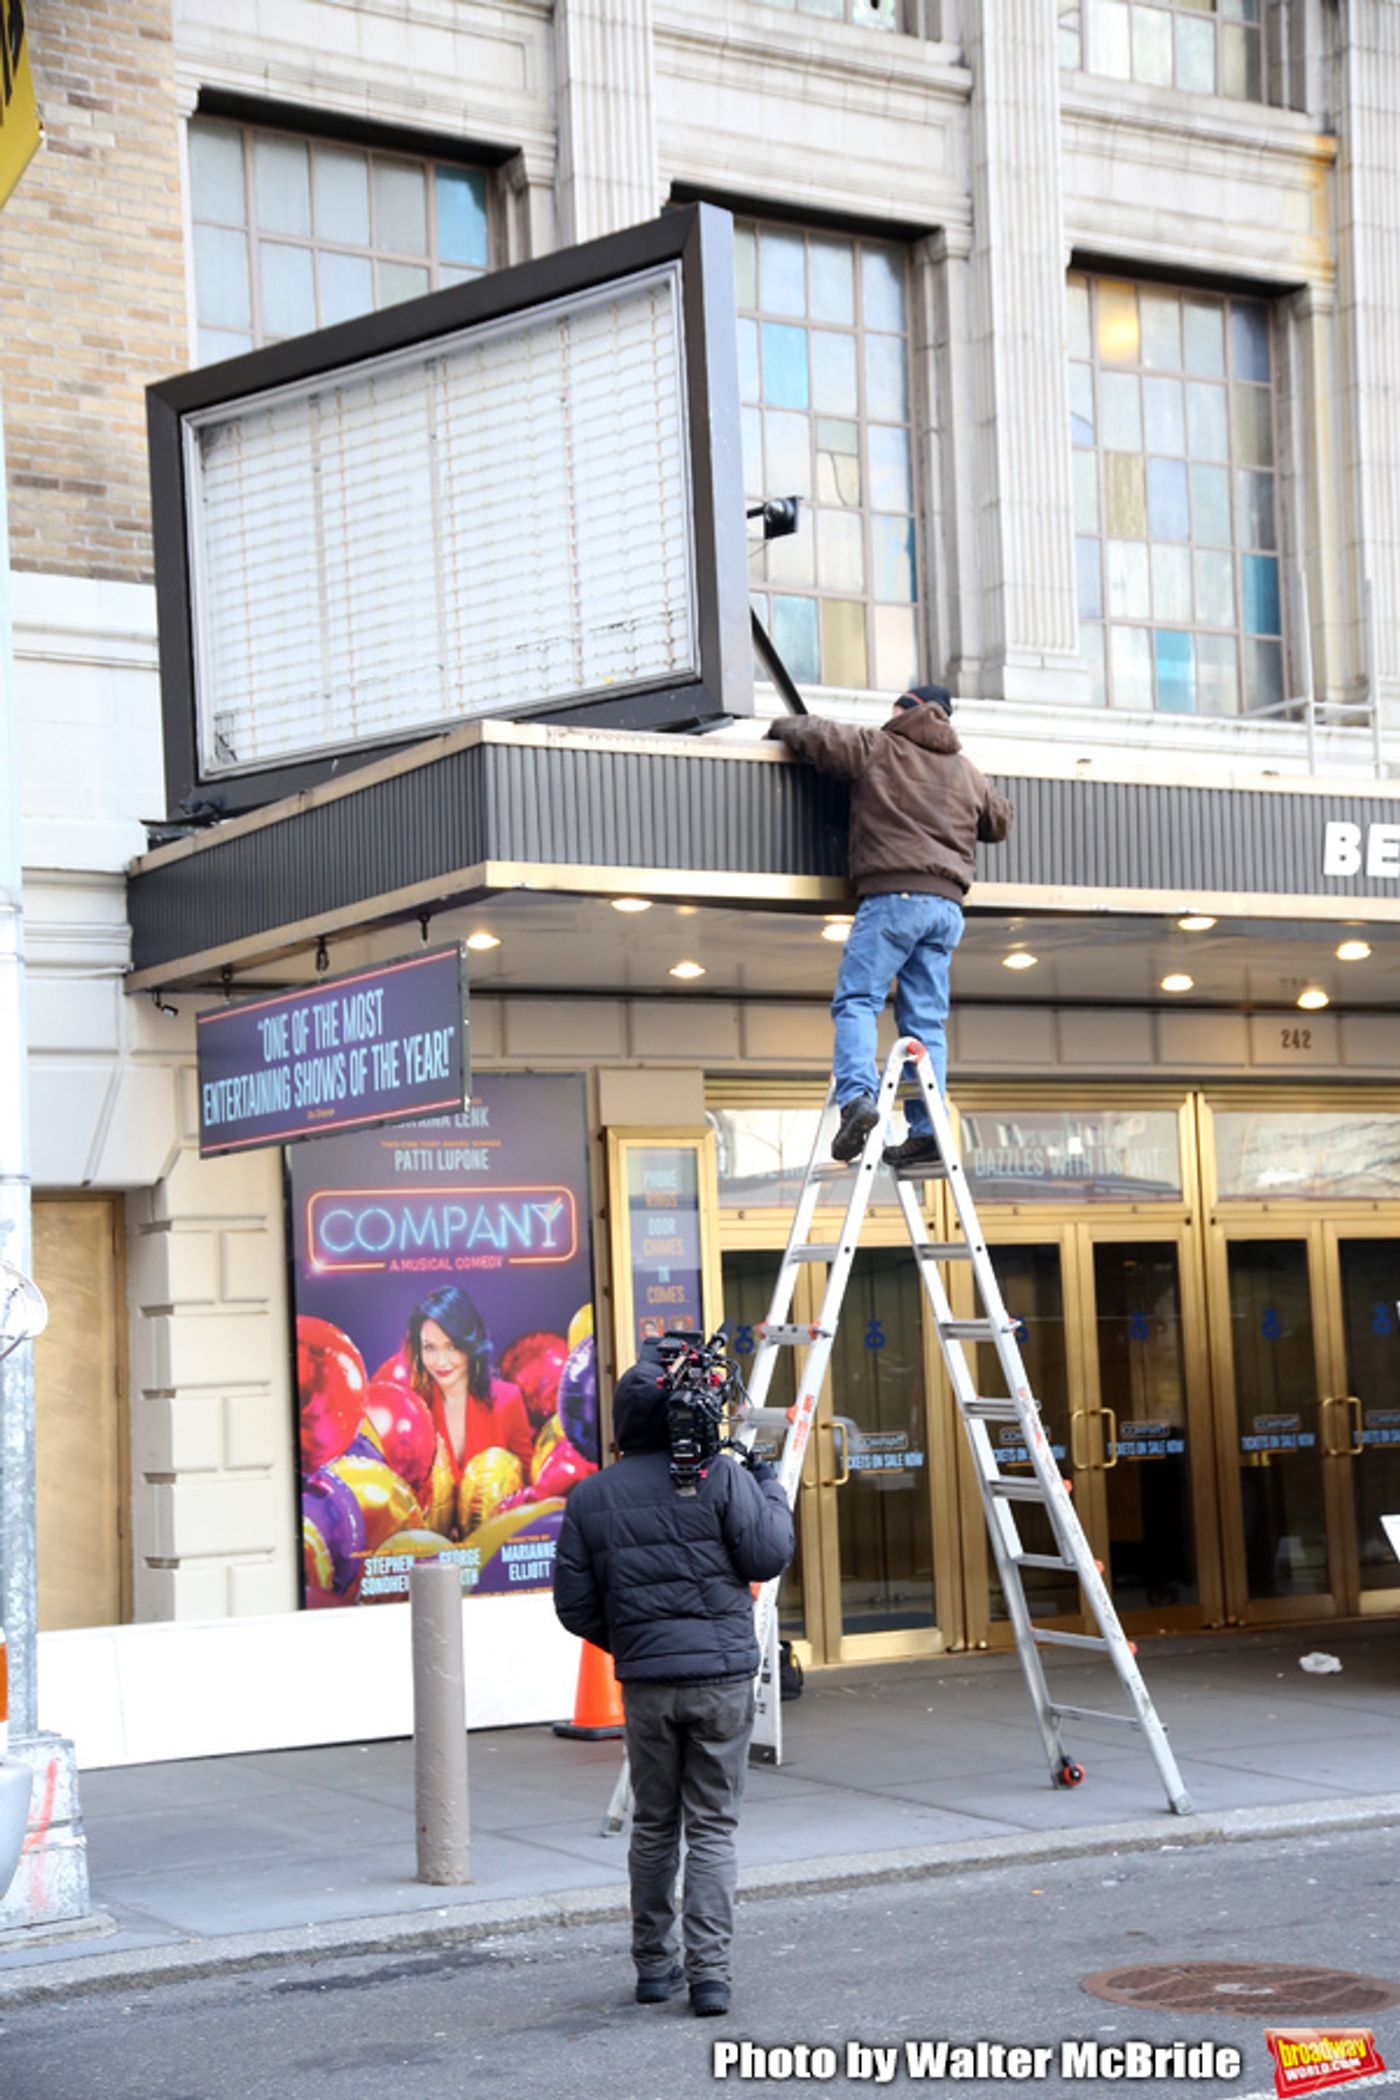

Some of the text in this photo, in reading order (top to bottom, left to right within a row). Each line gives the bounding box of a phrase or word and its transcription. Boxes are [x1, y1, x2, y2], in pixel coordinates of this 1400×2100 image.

[292, 1008, 310, 1056] OF
[312, 1001, 338, 1049] THE
[343, 988, 384, 1043] MOST
[1281, 1029, 1312, 1049] 242
[203, 1066, 291, 1126] ENTERTAINING
[294, 1053, 346, 1108] SHOWS
[349, 1048, 368, 1096] OF
[371, 1040, 400, 1091] THE
[454, 1106, 489, 1128] LENK
[395, 1148, 490, 1171] PATTI LUPONE
[974, 1147, 1044, 1177] DAZZLES
[319, 1199, 564, 1252] COMPANY
[389, 1255, 503, 1272] A MUSICAL COMEDY
[840, 1454, 872, 1470] TCKETS
[509, 1560, 550, 1581] ELLIOTT
